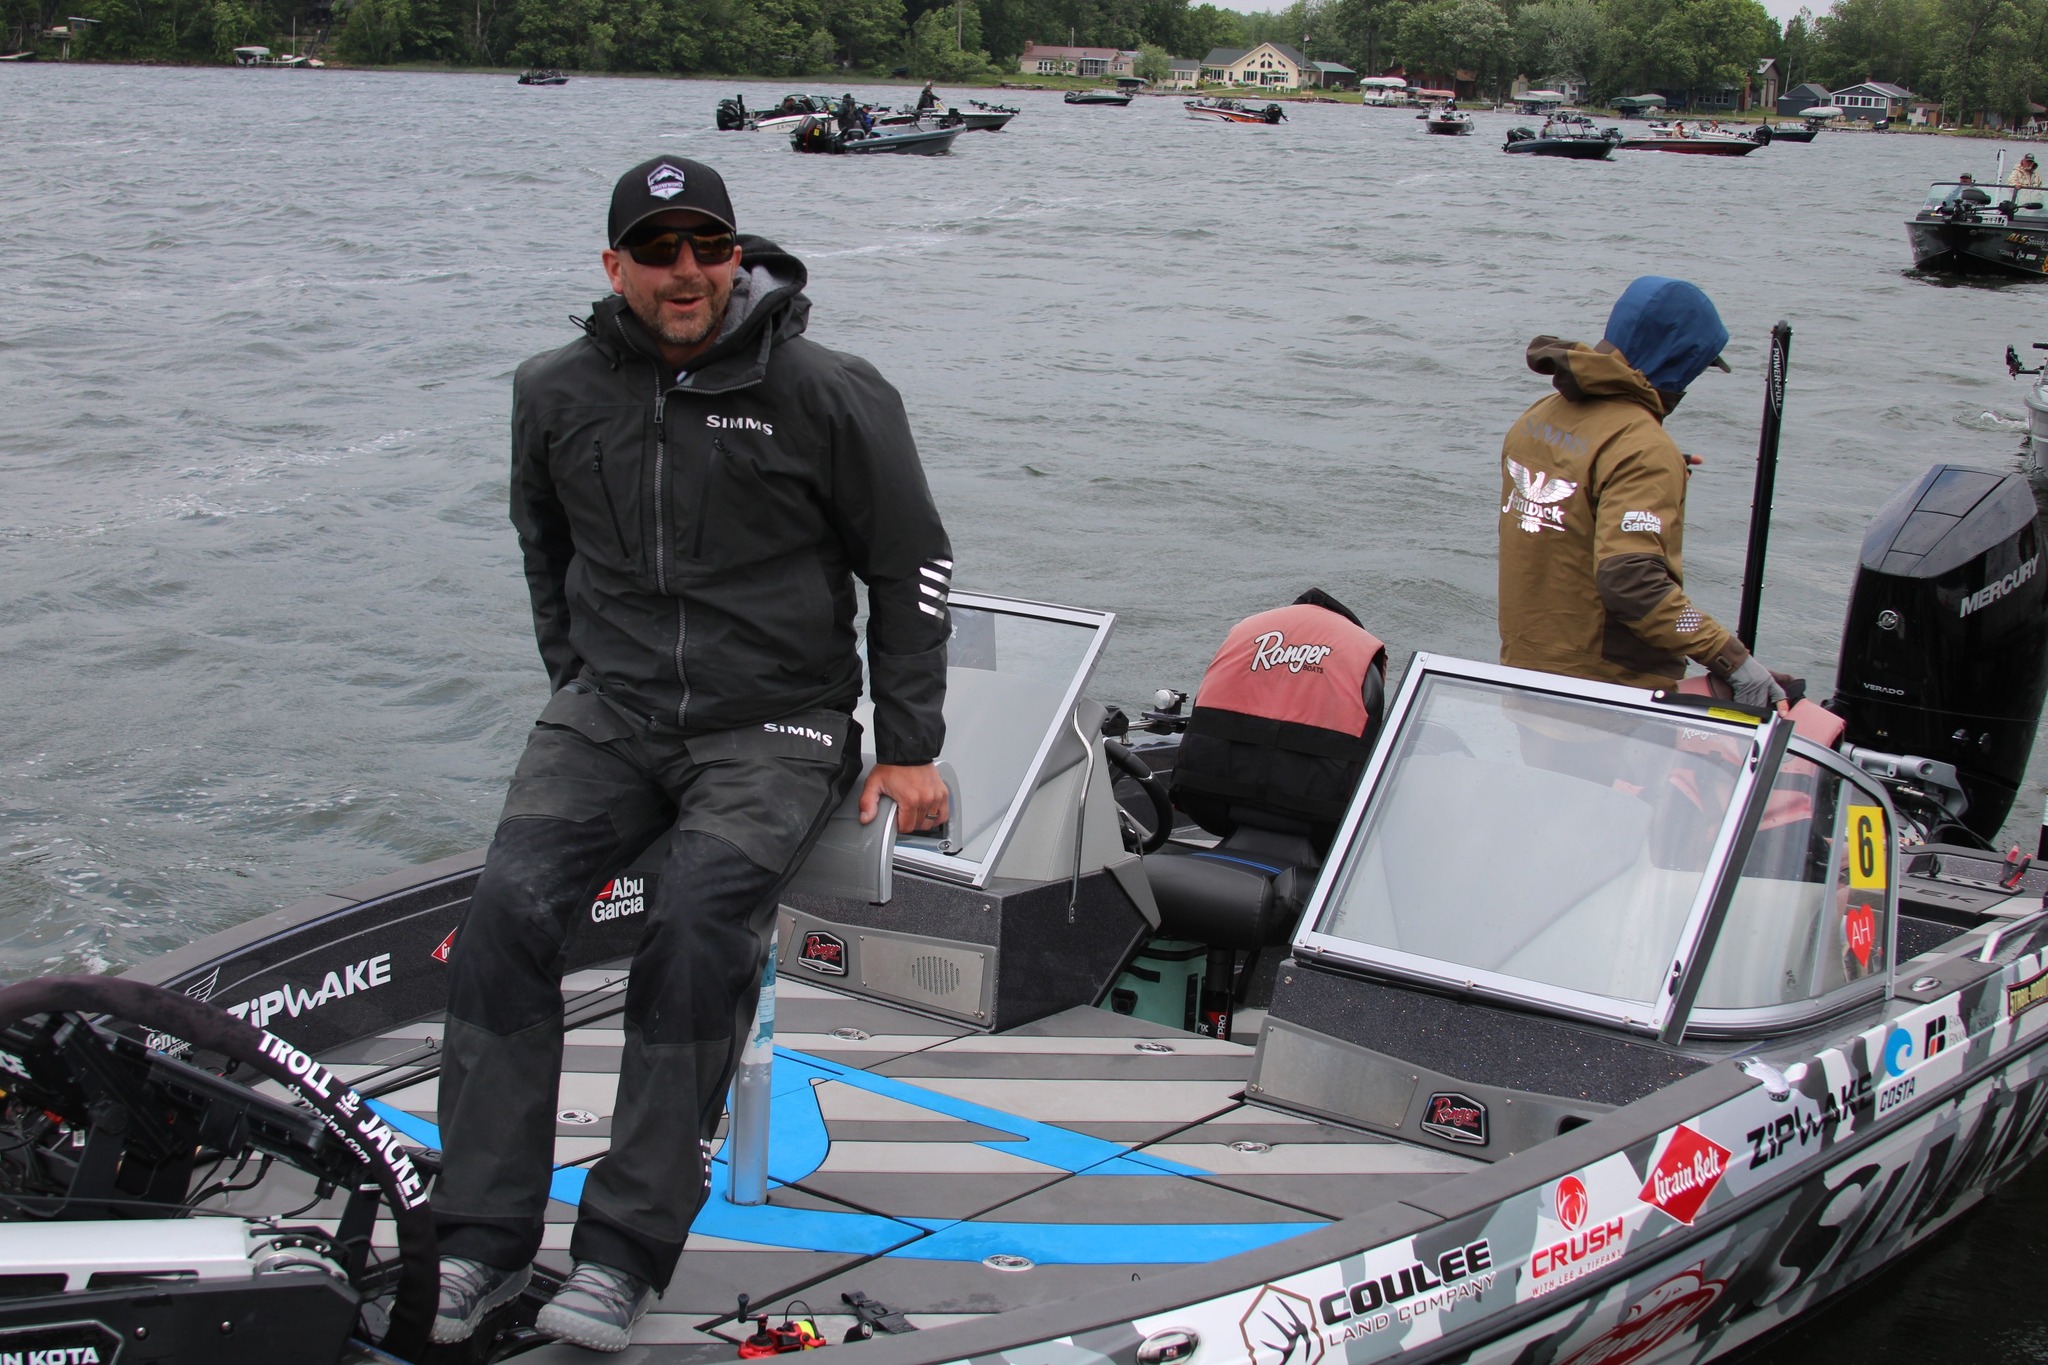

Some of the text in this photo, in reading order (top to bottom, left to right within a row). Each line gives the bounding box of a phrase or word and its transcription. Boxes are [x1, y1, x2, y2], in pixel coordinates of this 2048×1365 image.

[1773, 348, 1782, 409] POWER-POLE
[706, 414, 773, 436] SIMMS
[1502, 488, 1565, 525] fenwick
[1636, 511, 1662, 525] Abu
[1620, 519, 1662, 535] Garcia
[1960, 553, 2040, 619] MERCURY
[1251, 630, 1331, 674] Ranger
[1303, 664, 1324, 675] BOATS
[1863, 682, 1905, 696] VERADO
[764, 722, 833, 747] SIMMS
[1857, 815, 1874, 878] 6
[610, 876, 644, 901] Abu
[591, 895, 645, 923] Garcia
[1851, 916, 1871, 949] AH
[1433, 1097, 1480, 1127] Ranger
[1879, 1076, 1916, 1112] COSTA
[258, 1029, 429, 1209] TROLL JACKET
[1653, 1146, 1722, 1206] Grain Belt
[1531, 1216, 1624, 1279] CRUSH
[1319, 1238, 1492, 1326] COULEE
[1532, 1279, 1555, 1296] WITH
[1559, 1270, 1574, 1285] LEE
[1587, 1248, 1622, 1272] TIFFANY
[1328, 1271, 1497, 1347] LAND COMPANY
[28, 1346, 100, 1365] KOTA
